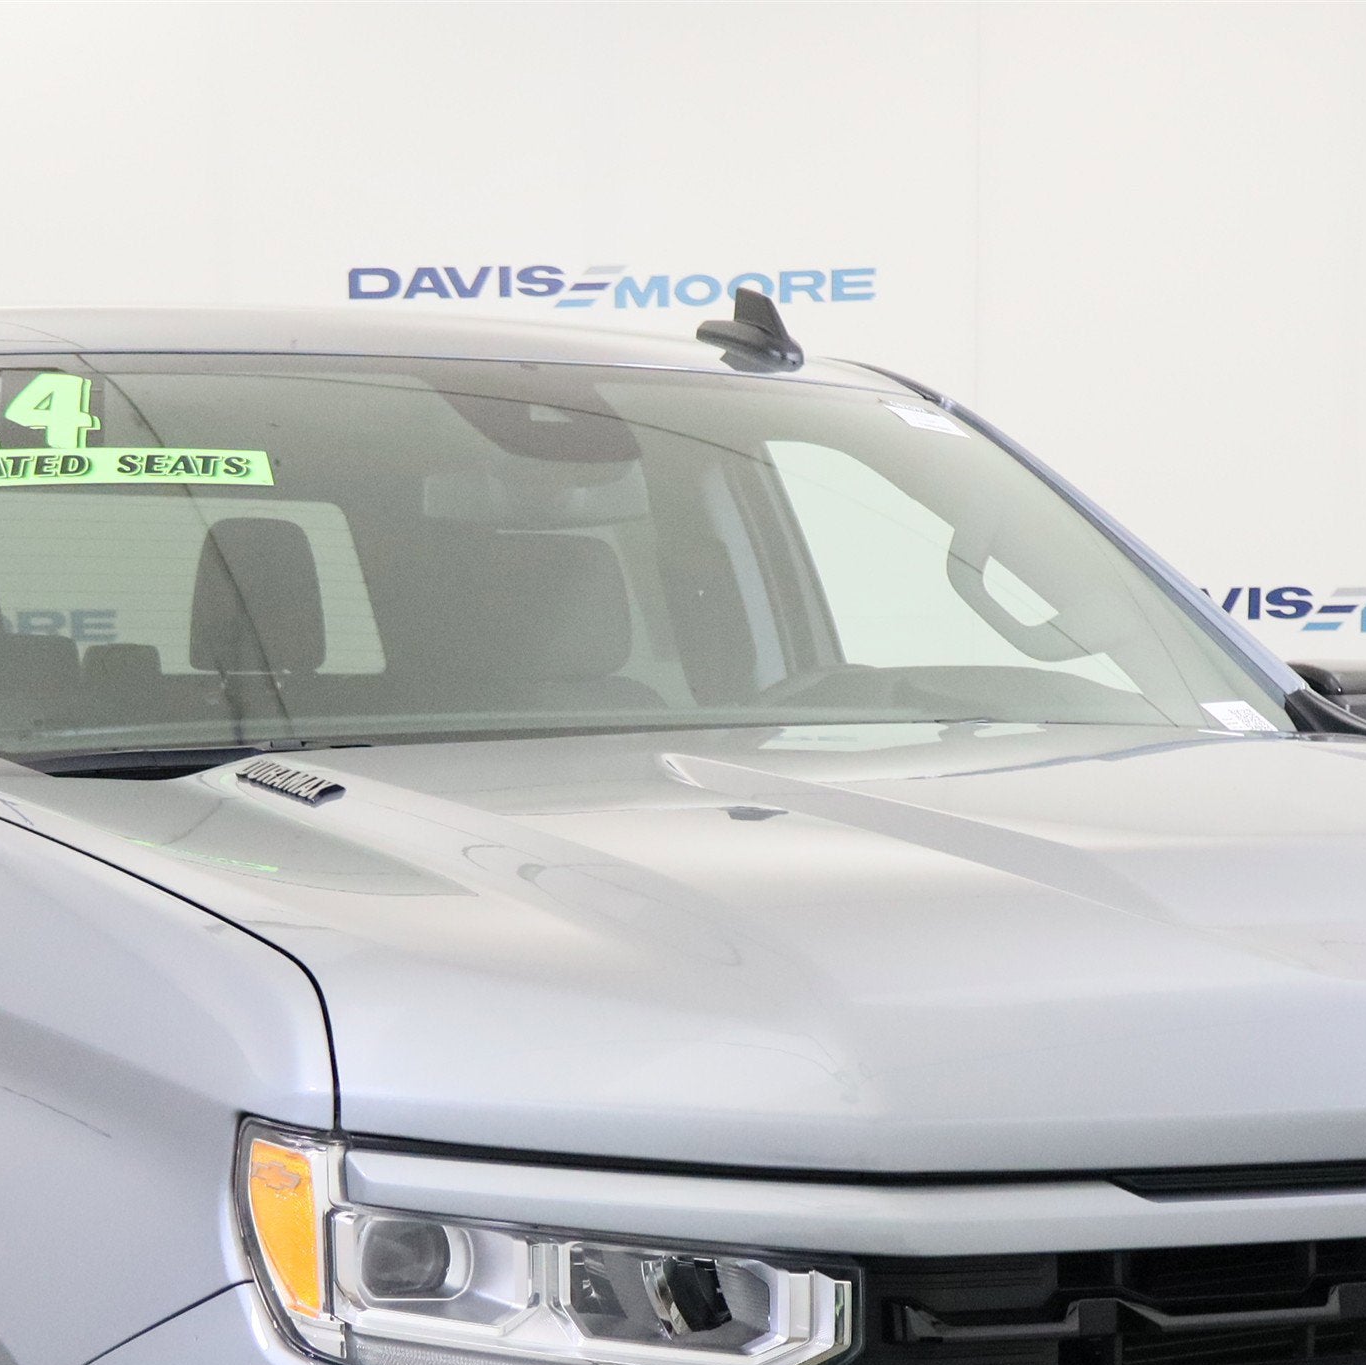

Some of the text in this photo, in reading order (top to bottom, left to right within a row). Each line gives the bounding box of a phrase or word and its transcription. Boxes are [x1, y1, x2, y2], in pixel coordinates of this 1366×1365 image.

[347, 265, 564, 300] DAVIS
[116, 453, 252, 480] SEATS
[1200, 586, 1314, 620] VIS
[235, 759, 335, 803] DURAMAX
